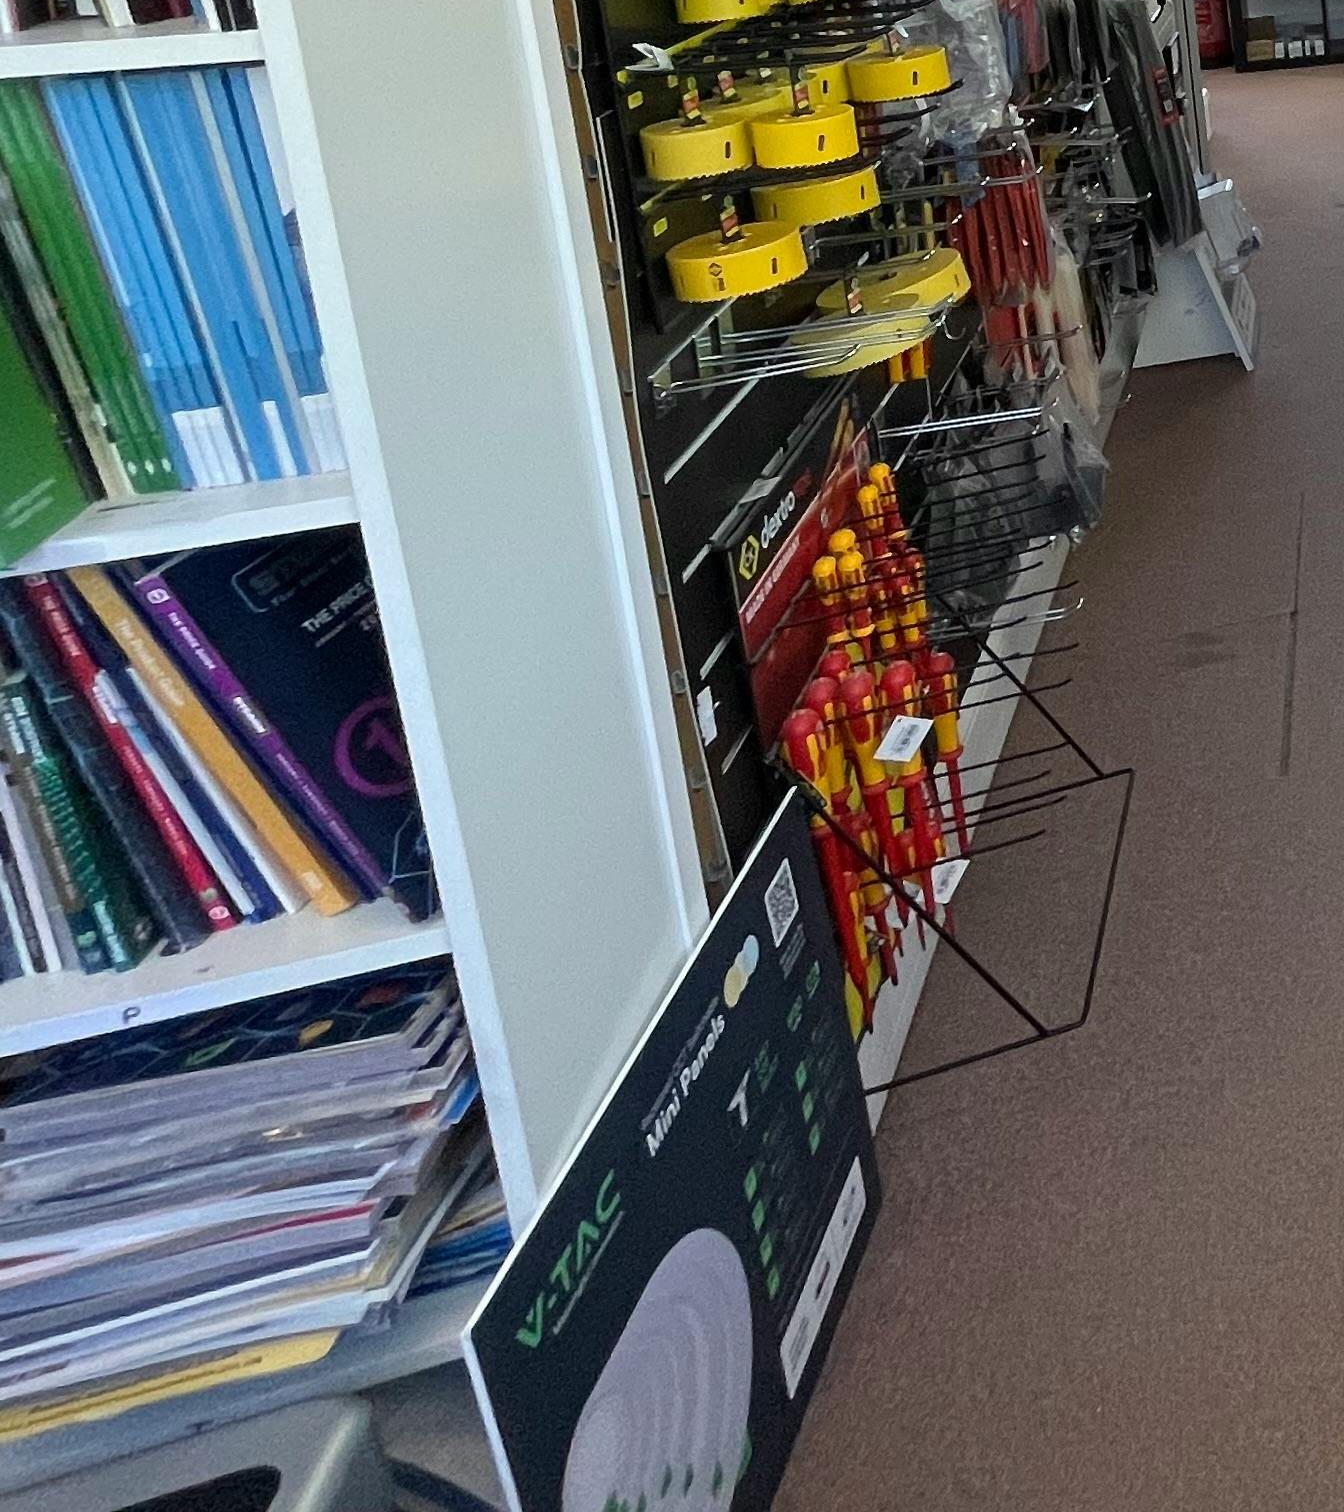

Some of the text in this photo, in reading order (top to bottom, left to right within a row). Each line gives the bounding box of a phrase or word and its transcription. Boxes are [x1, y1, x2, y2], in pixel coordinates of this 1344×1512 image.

[646, 1088, 682, 1157] Mini
[679, 1014, 726, 1097] Panels
[514, 1168, 621, 1348] V-TAC
